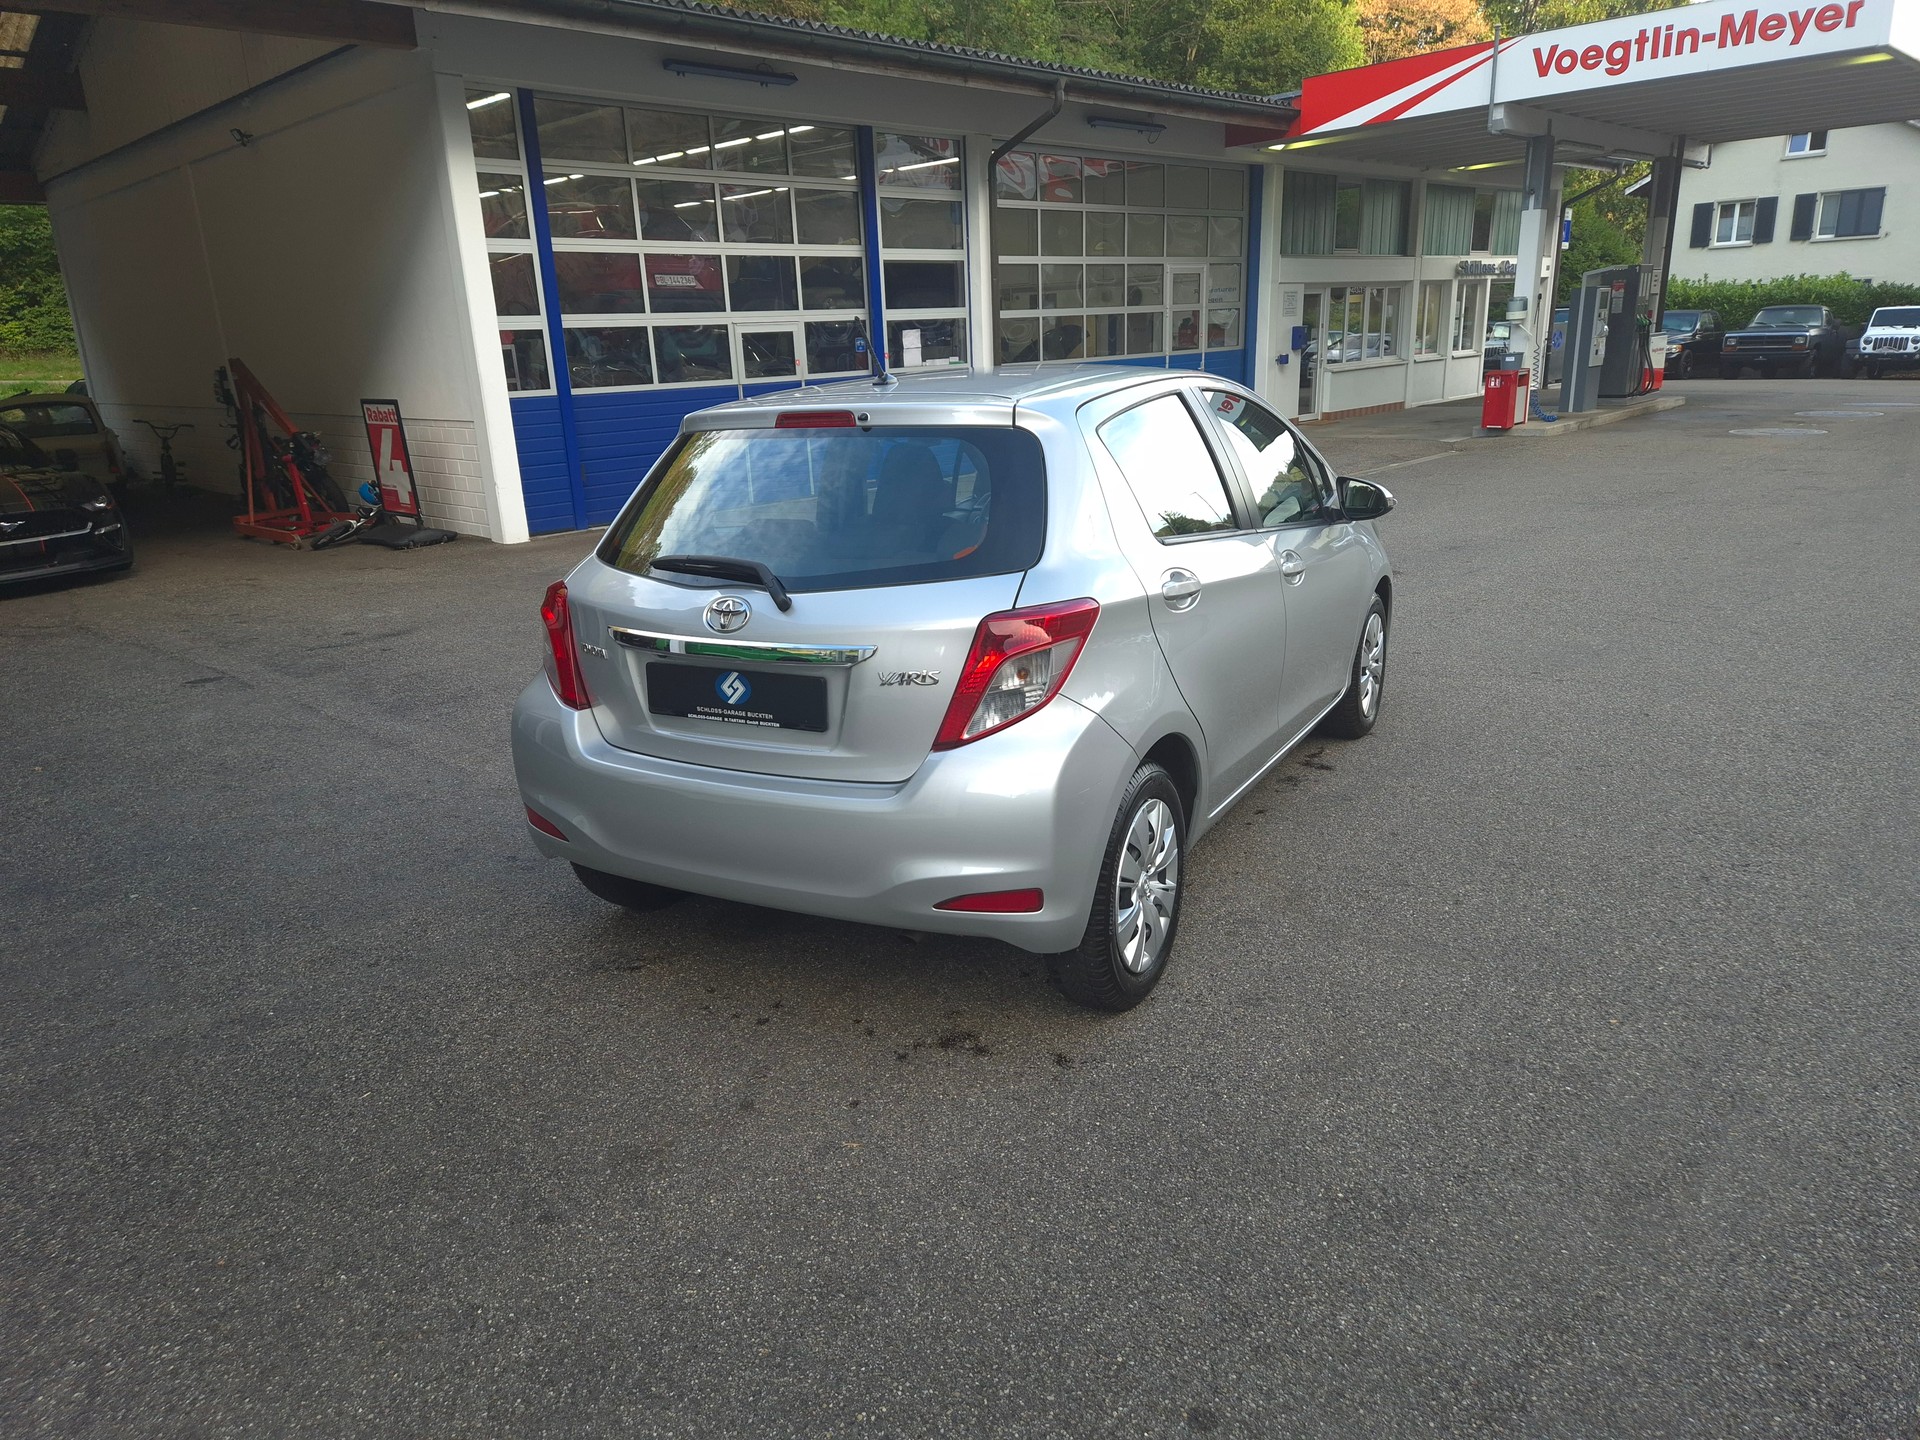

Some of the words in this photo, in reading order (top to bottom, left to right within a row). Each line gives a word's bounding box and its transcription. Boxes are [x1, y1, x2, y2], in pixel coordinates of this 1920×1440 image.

[1532, 0, 1866, 78] Voegtlin-Meyer
[365, 406, 398, 423] Rabatt
[379, 428, 412, 504] 4
[877, 669, 941, 687] YARIS
[687, 713, 722, 721] SCHLOSS-GARAGE
[696, 706, 746, 717] SCHLOSS-GARAGE
[747, 711, 773, 719] BUCKTEN
